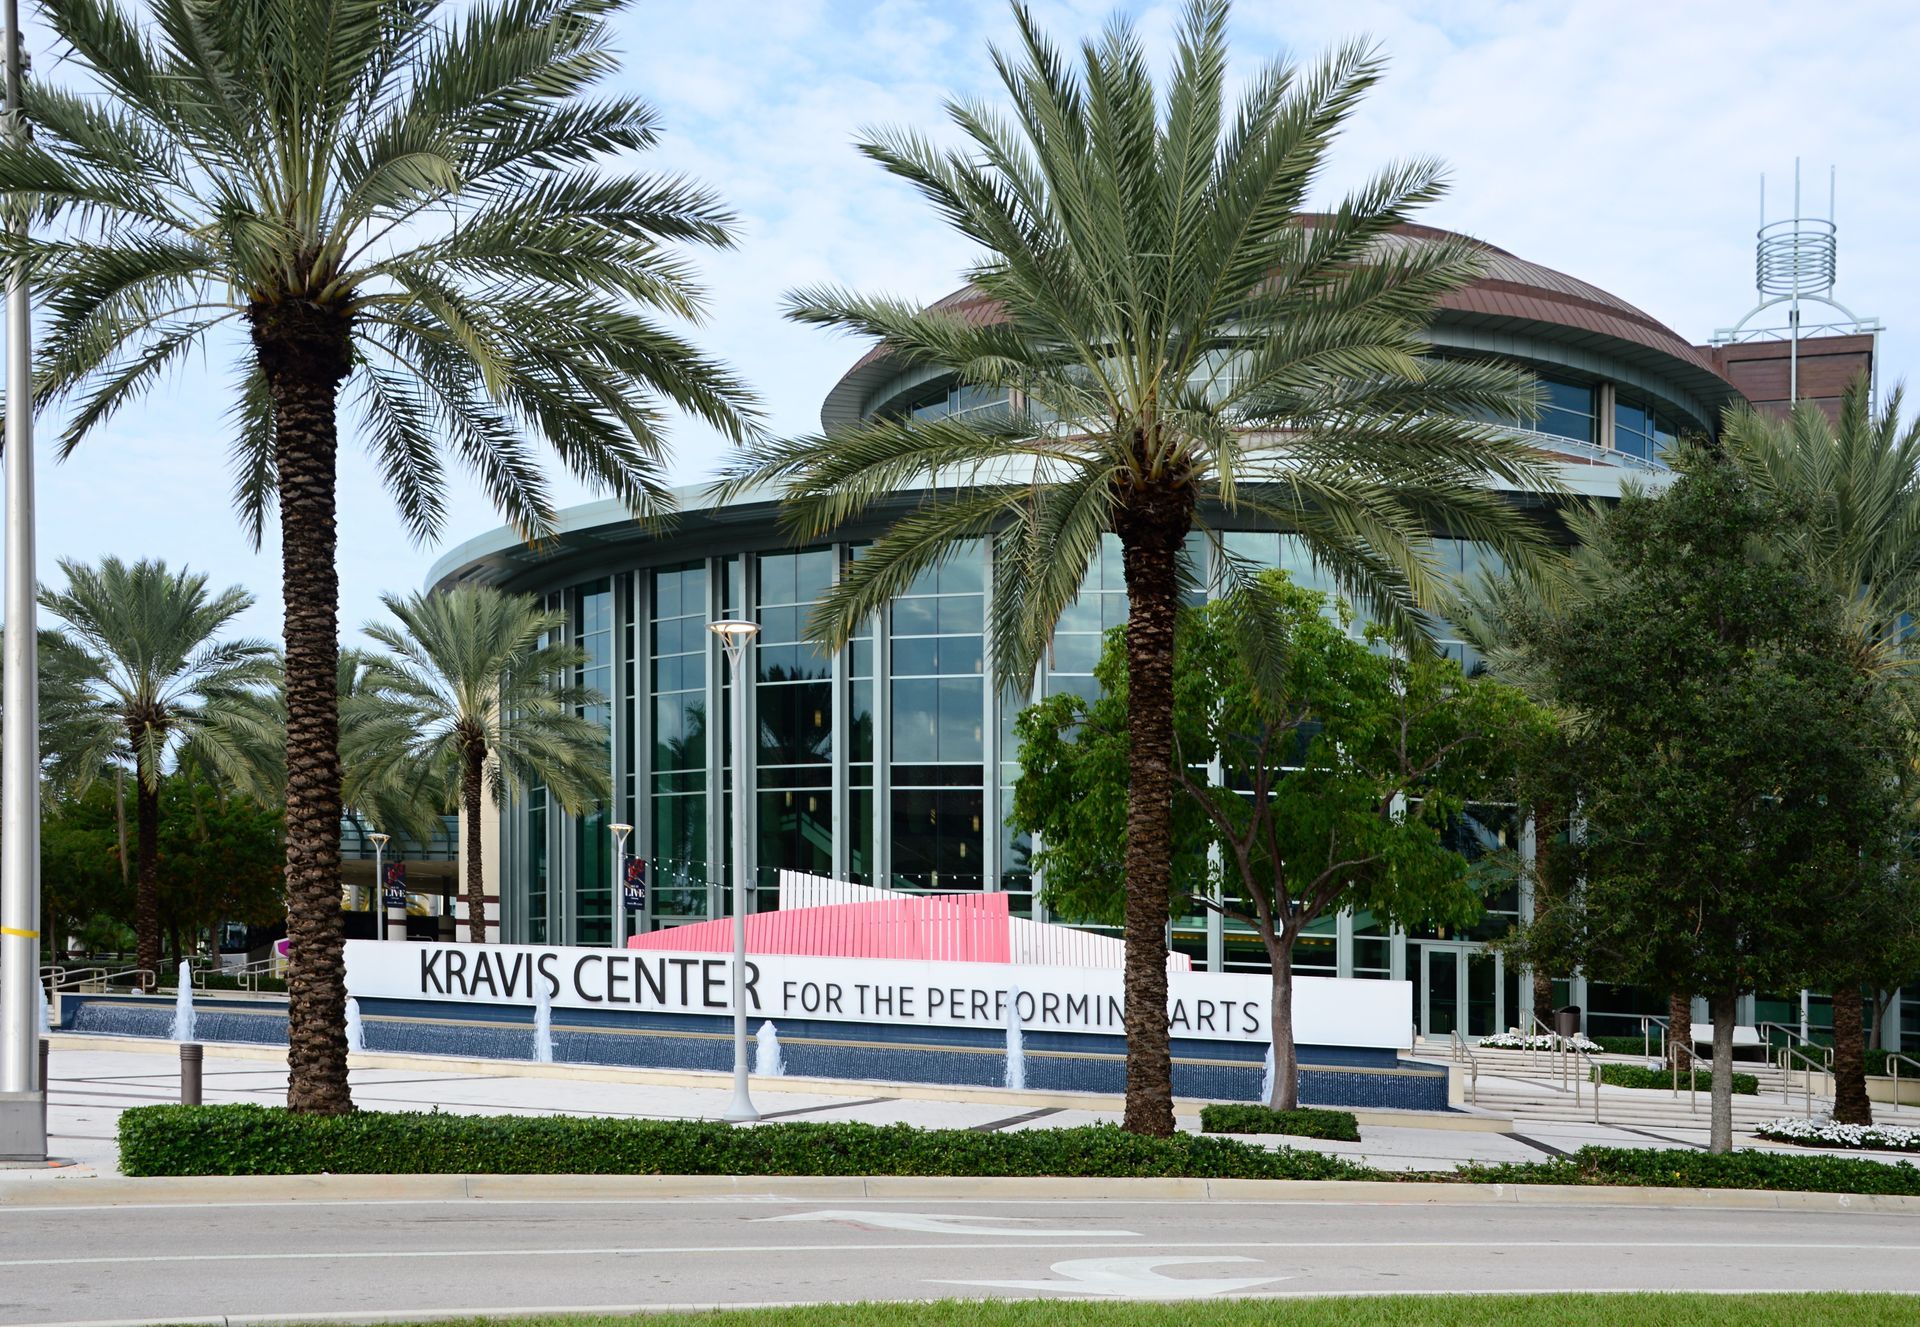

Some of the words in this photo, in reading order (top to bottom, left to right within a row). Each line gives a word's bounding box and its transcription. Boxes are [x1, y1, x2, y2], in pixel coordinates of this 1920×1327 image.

[385, 888, 406, 898] LIVE
[625, 887, 646, 898] LIVE
[420, 949, 560, 999] KRAVIS
[573, 954, 762, 1010] CENTER
[783, 981, 843, 1014] FOR
[854, 984, 915, 1018] THE
[928, 986, 1127, 1027] PERFORMIN
[1169, 998, 1260, 1033] ARTS
